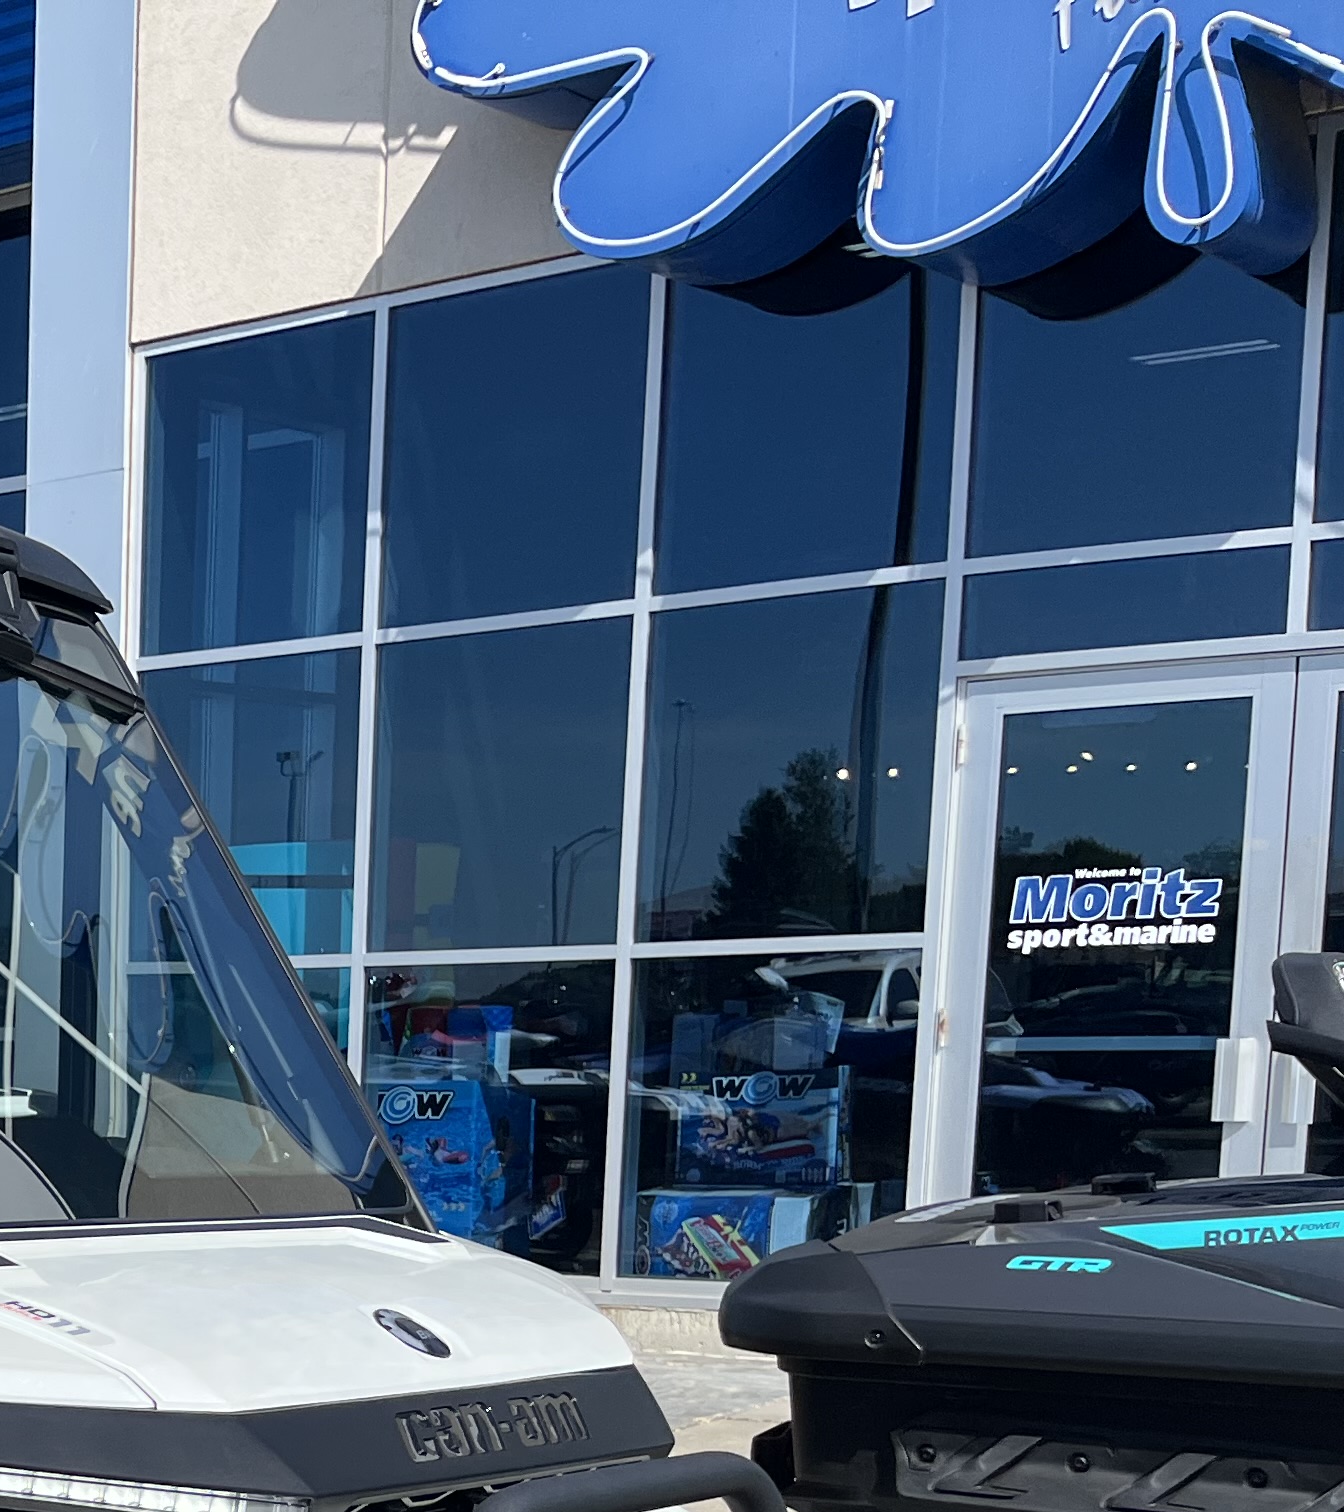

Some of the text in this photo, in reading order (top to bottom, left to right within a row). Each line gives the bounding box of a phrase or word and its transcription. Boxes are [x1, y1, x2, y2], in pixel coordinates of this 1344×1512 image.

[1075, 867, 1142, 880] Welcome to
[1009, 867, 1223, 924] Moritz
[1007, 919, 1216, 955] sport&marine
[378, 1086, 454, 1125] OW
[712, 1071, 815, 1106] WOW
[1203, 1220, 1341, 1249] ROTAX POWER
[1005, 1255, 1113, 1274] GTR
[395, 1391, 591, 1463] can-am
